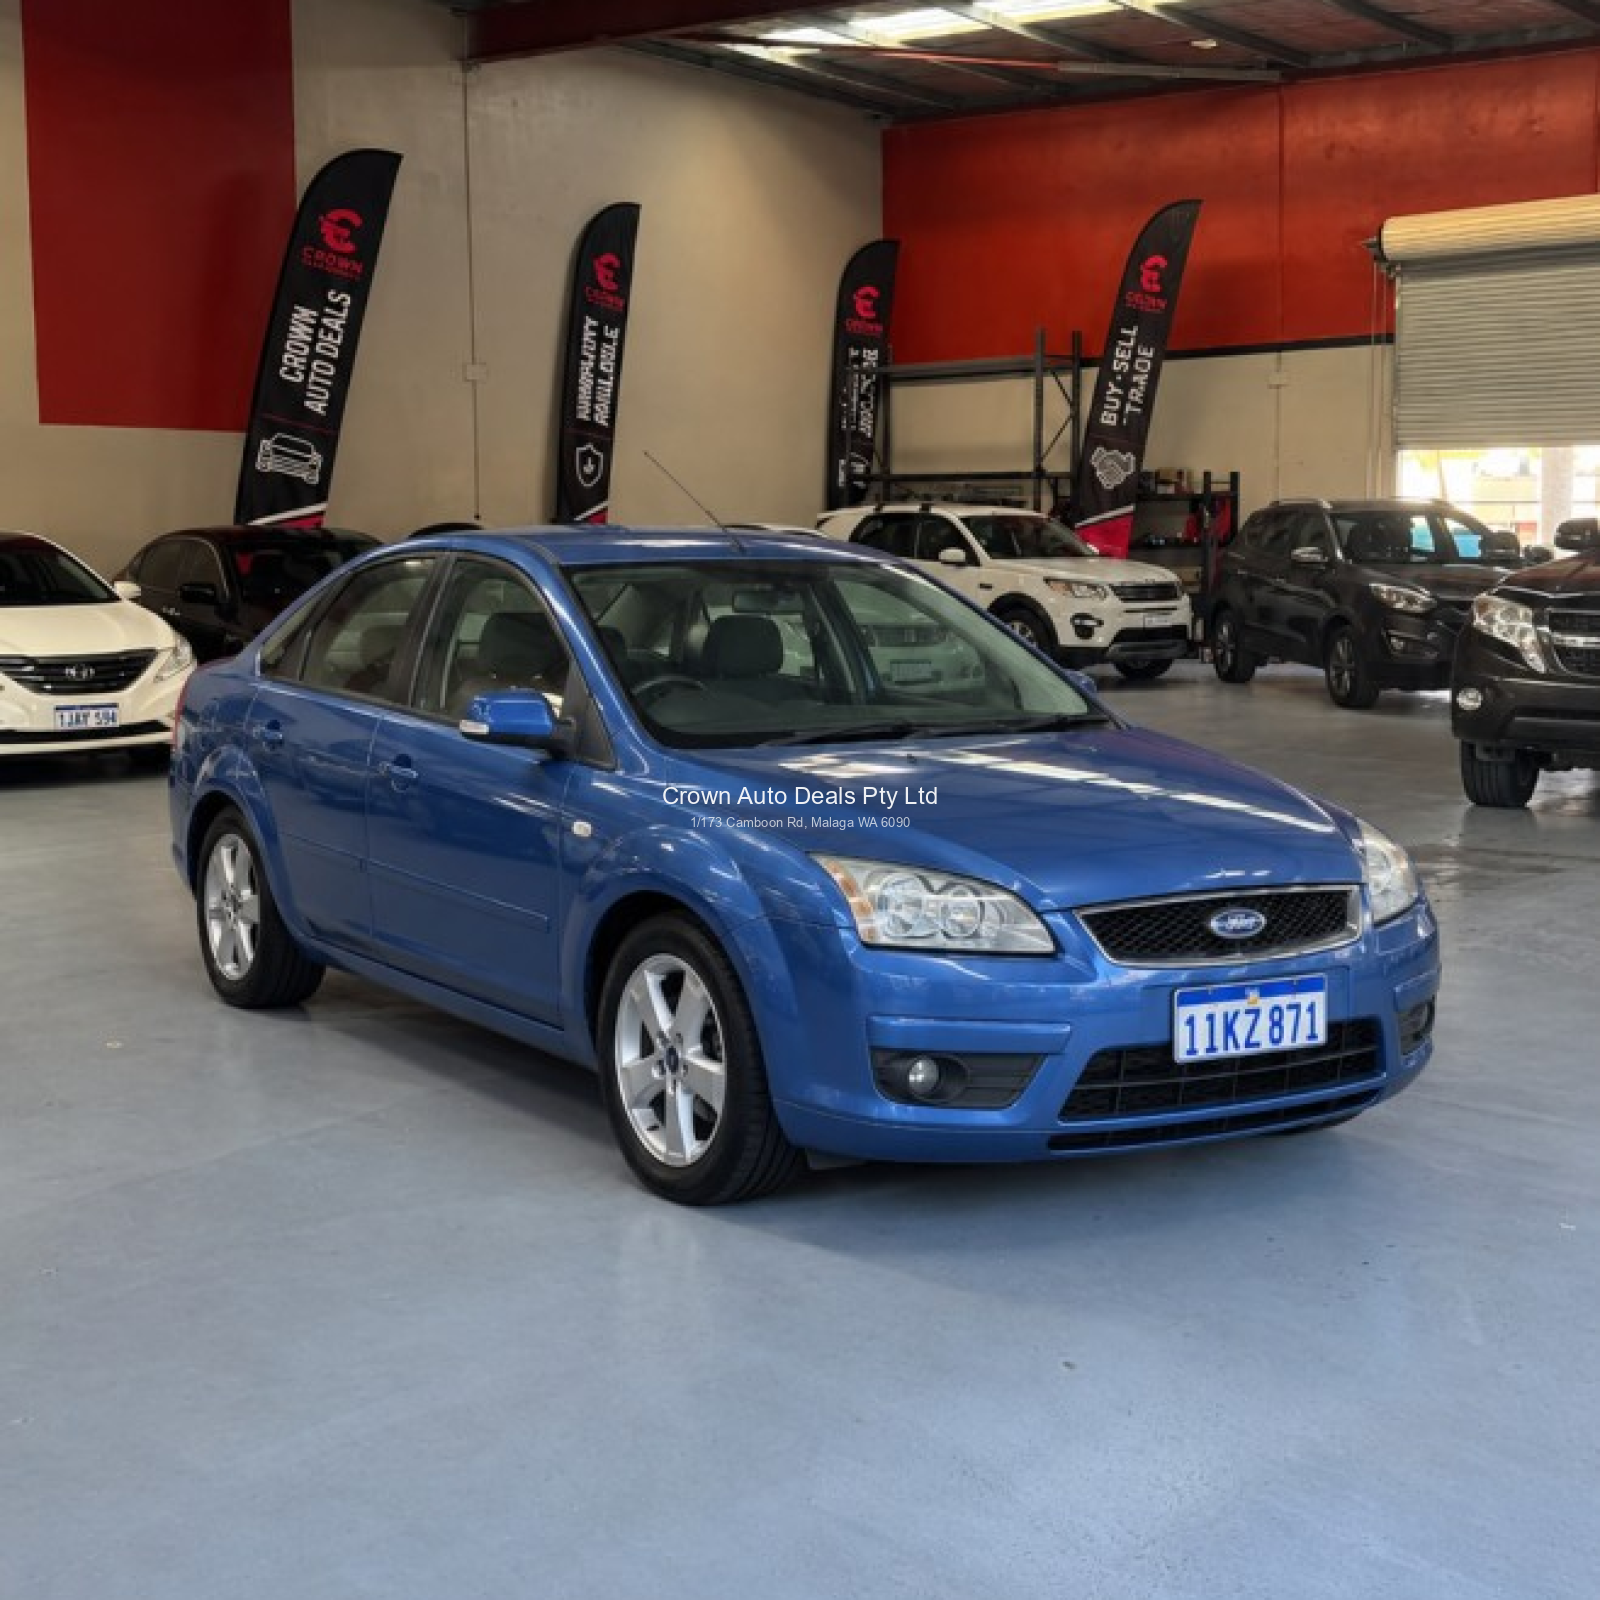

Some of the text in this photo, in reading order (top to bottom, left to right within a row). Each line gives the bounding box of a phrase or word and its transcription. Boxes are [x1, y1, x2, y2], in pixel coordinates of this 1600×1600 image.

[280, 305, 319, 383] CROWN
[318, 289, 351, 358] DEALS
[304, 360, 336, 415] AUTO
